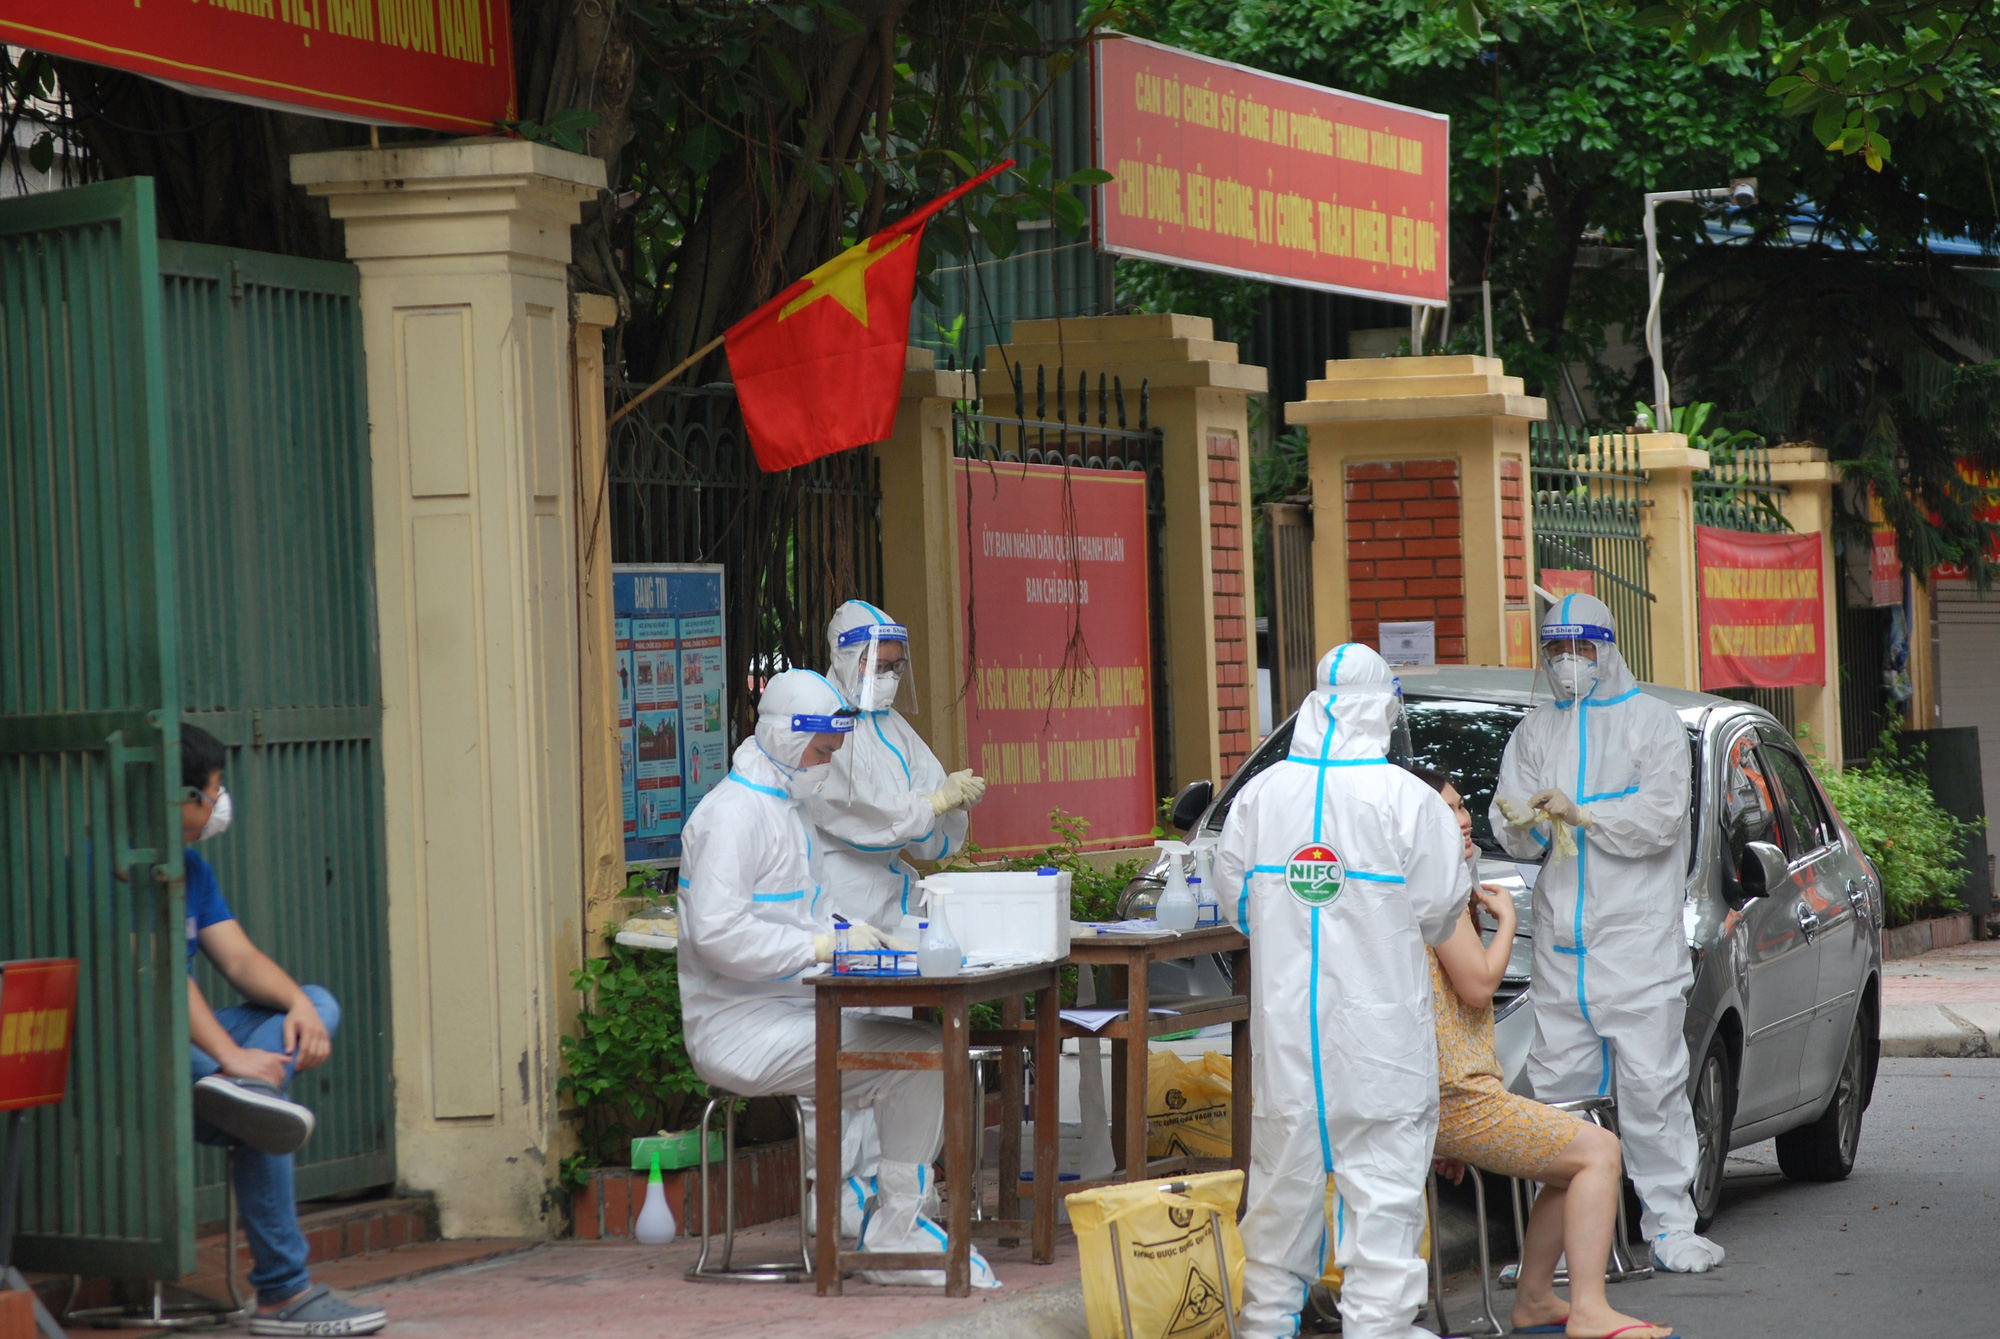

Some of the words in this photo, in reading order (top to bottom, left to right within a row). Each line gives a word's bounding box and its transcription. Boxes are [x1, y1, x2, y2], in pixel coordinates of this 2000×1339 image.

[1135, 66, 1161, 114] CÁN
[1164, 74, 1181, 128] BỘ
[1183, 77, 1219, 129] CHIẾN
[1239, 94, 1270, 142] CÔNG
[1271, 109, 1288, 146] AN
[1290, 108, 1334, 157] PHƯỜNG
[1335, 122, 1369, 165] THANH
[1370, 126, 1398, 171] XUÂN
[1399, 136, 1423, 176] NAM
[1147, 153, 1185, 235] ĐỘNG,
[1187, 162, 1212, 231] NÊU
[1214, 173, 1258, 247] GƯƠNG,
[1259, 168, 1273, 244] KỶ
[1318, 192, 1352, 258] TRÁCH
[1391, 206, 1414, 278] HIỆU
[982, 523, 994, 557] ỦY
[995, 531, 1013, 558] BAN
[1013, 528, 1037, 559] NHÂN
[1037, 529, 1054, 560] DÂN
[1077, 536, 1103, 561] THANH
[1103, 532, 1125, 562] XUÂN
[1026, 577, 1042, 603] BAN
[1043, 570, 1057, 603] CHỈ
[1057, 578, 1074, 611] ĐẠO
[986, 659, 1006, 710] SỨC
[1007, 653, 1031, 710] KHỎE
[1032, 653, 1051, 710] CỦA
[1099, 667, 1122, 716] HẠNH
[1123, 657, 1145, 706] PHÚC
[981, 729, 1001, 785] CỦA
[1002, 742, 1020, 794] MỌI
[1021, 732, 1041, 783] NHÀ
[1047, 733, 1064, 782] HÃY
[1065, 731, 1094, 782] TRÁNH
[1094, 739, 1106, 779] XA
[1107, 738, 1121, 778] MA
[304, 1321, 351, 1336] crocs
